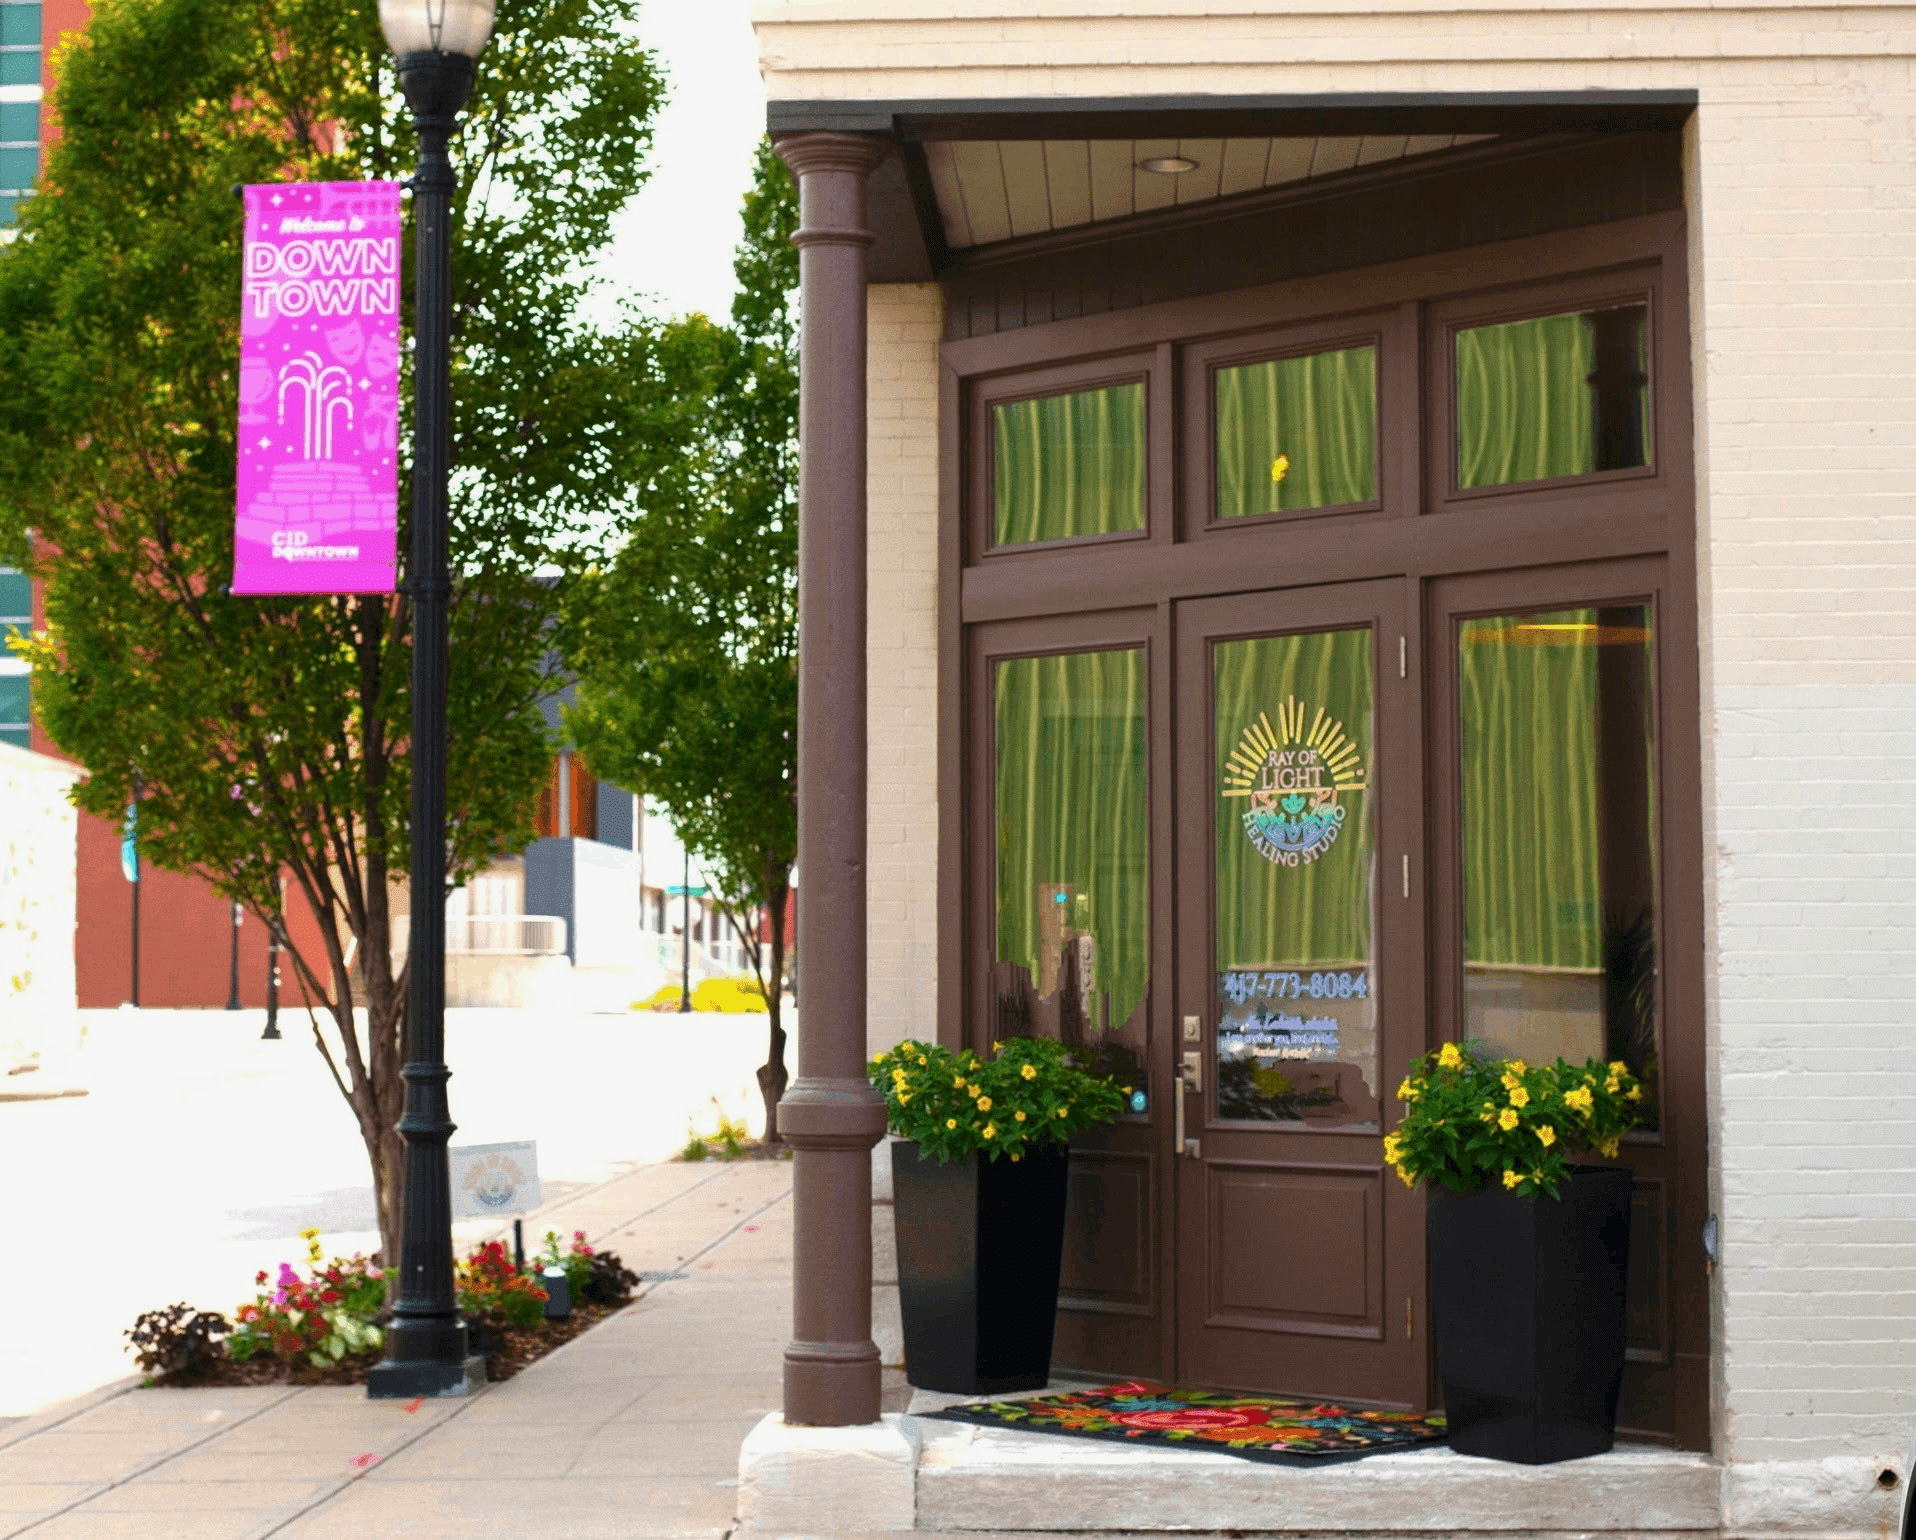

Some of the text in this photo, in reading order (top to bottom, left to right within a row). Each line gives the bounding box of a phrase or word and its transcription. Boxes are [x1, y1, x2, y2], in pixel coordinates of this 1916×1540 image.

[247, 237, 396, 278] DOWN
[246, 277, 396, 317] TOWN
[1261, 766, 1325, 790] LIGHT
[1268, 749, 1318, 767] RAY OF
[1241, 805, 1346, 868] HEALING STUDIO
